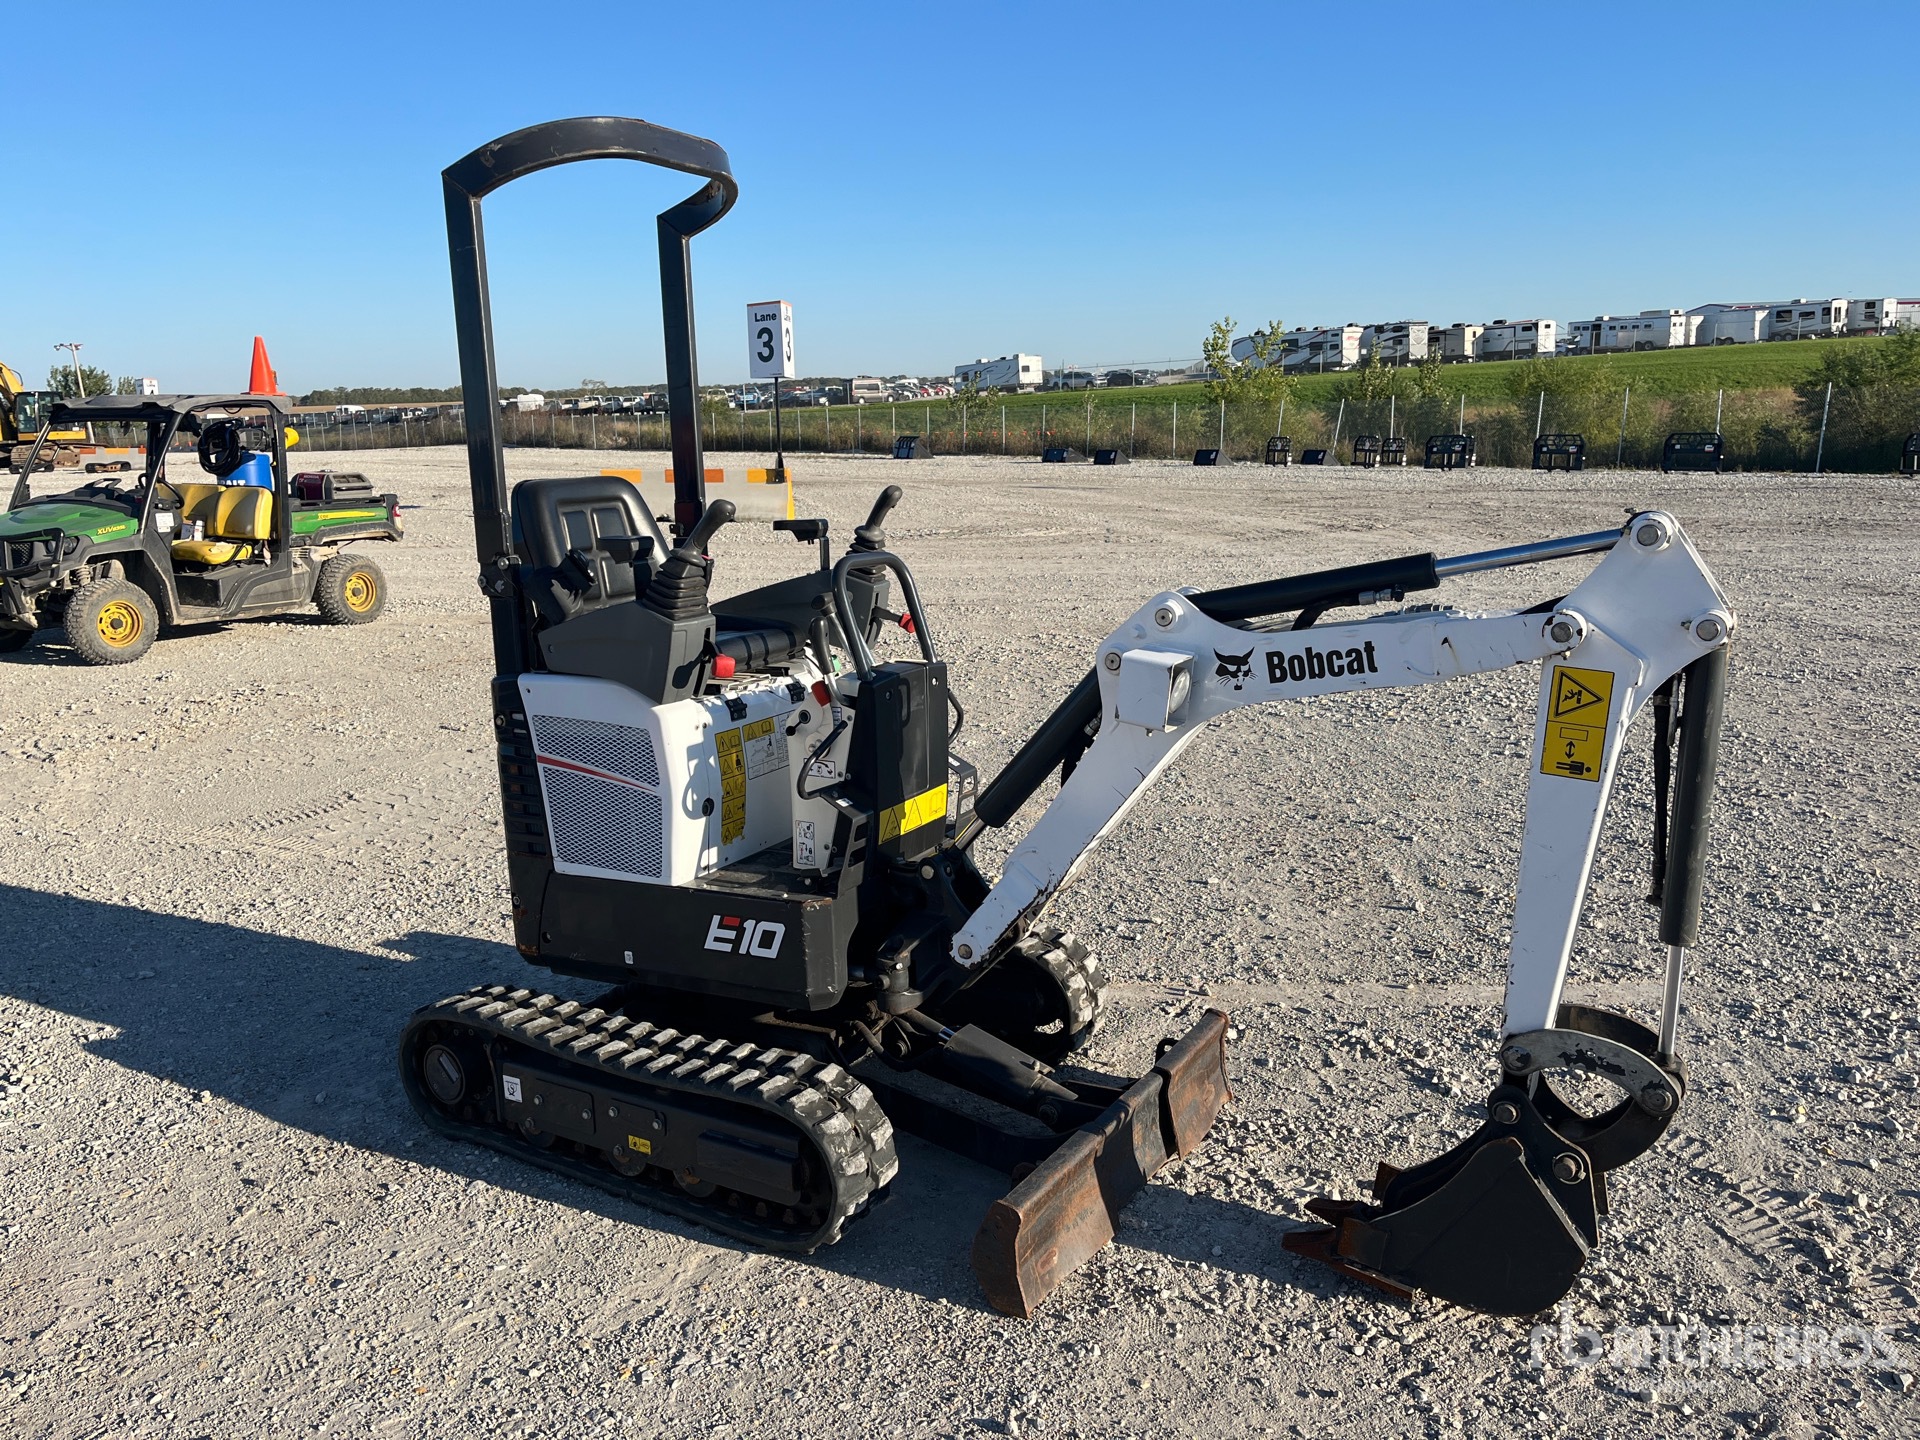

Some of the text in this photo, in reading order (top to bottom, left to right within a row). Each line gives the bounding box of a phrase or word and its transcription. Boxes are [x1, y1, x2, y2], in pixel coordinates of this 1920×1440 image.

[754, 312, 777, 322] Lane
[756, 327, 775, 363] 3
[785, 327, 792, 362] 3
[1266, 641, 1378, 684] Bobcat
[704, 914, 786, 959] E10
